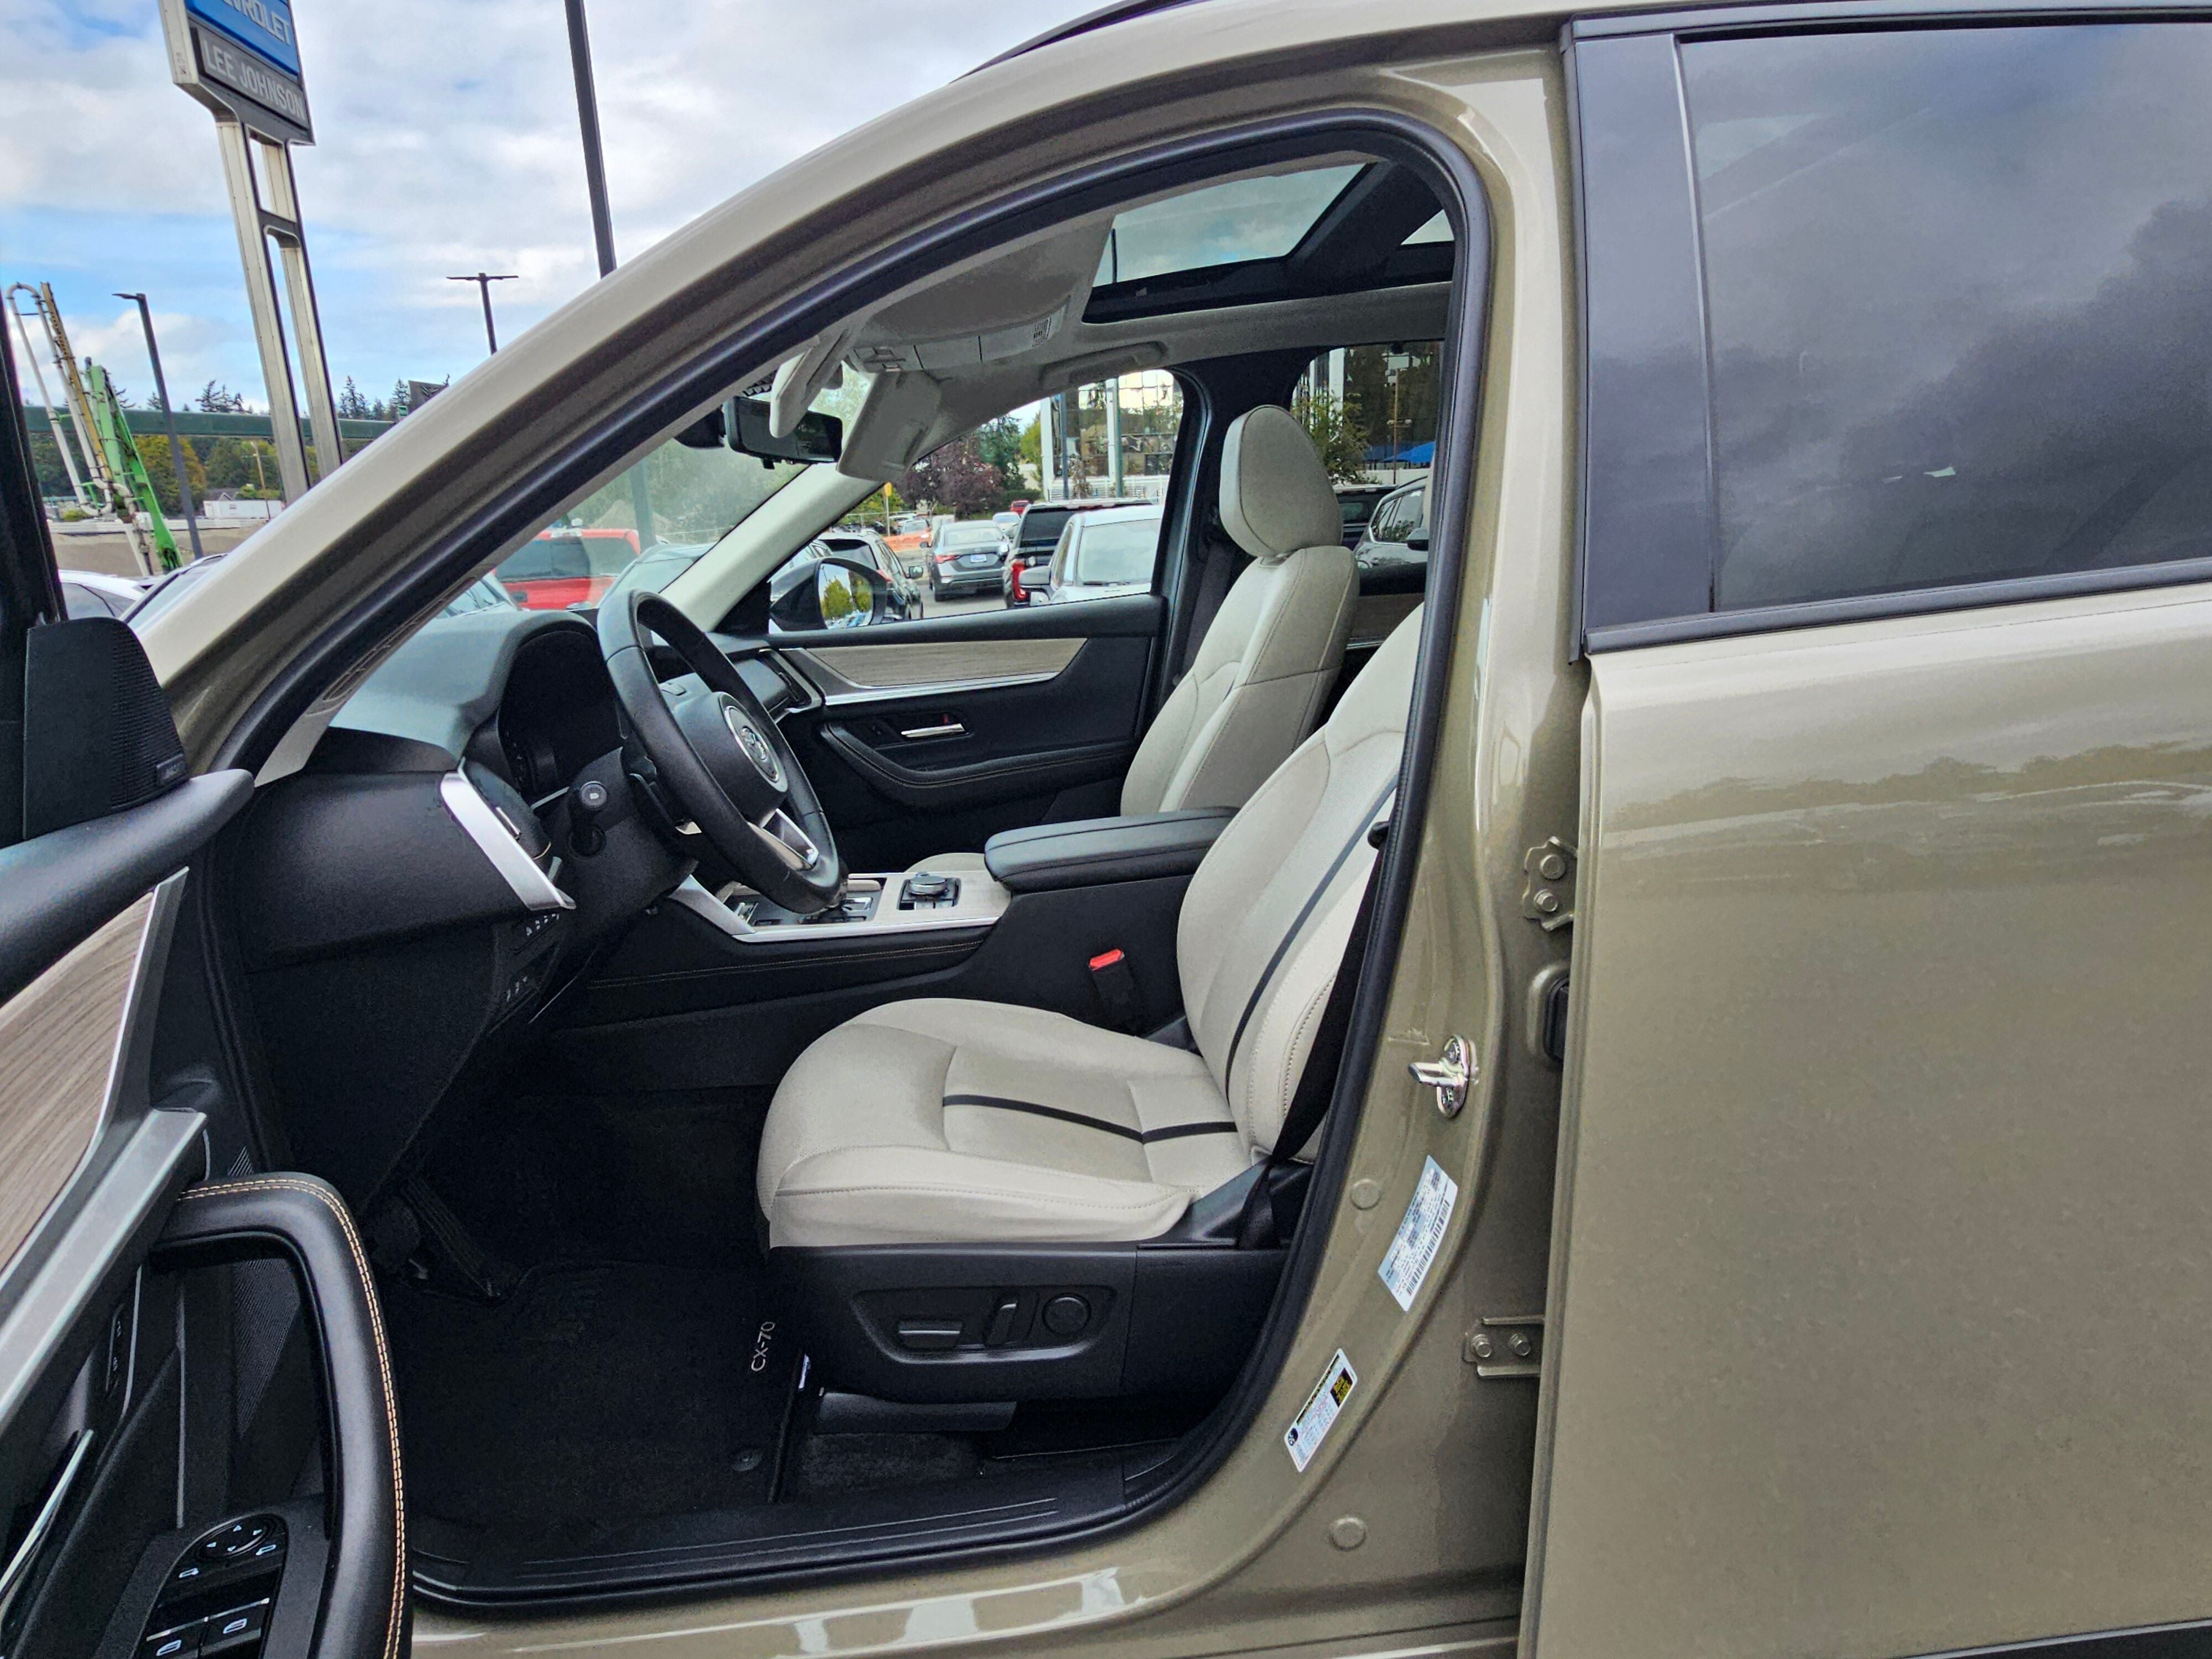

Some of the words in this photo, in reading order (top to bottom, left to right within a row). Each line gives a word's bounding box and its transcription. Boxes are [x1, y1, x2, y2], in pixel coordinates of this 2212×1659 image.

[222, 0, 291, 46] ROLET
[203, 39, 237, 81] LEE
[241, 62, 305, 120] JOHNSON
[751, 1322, 775, 1371] CX-70
